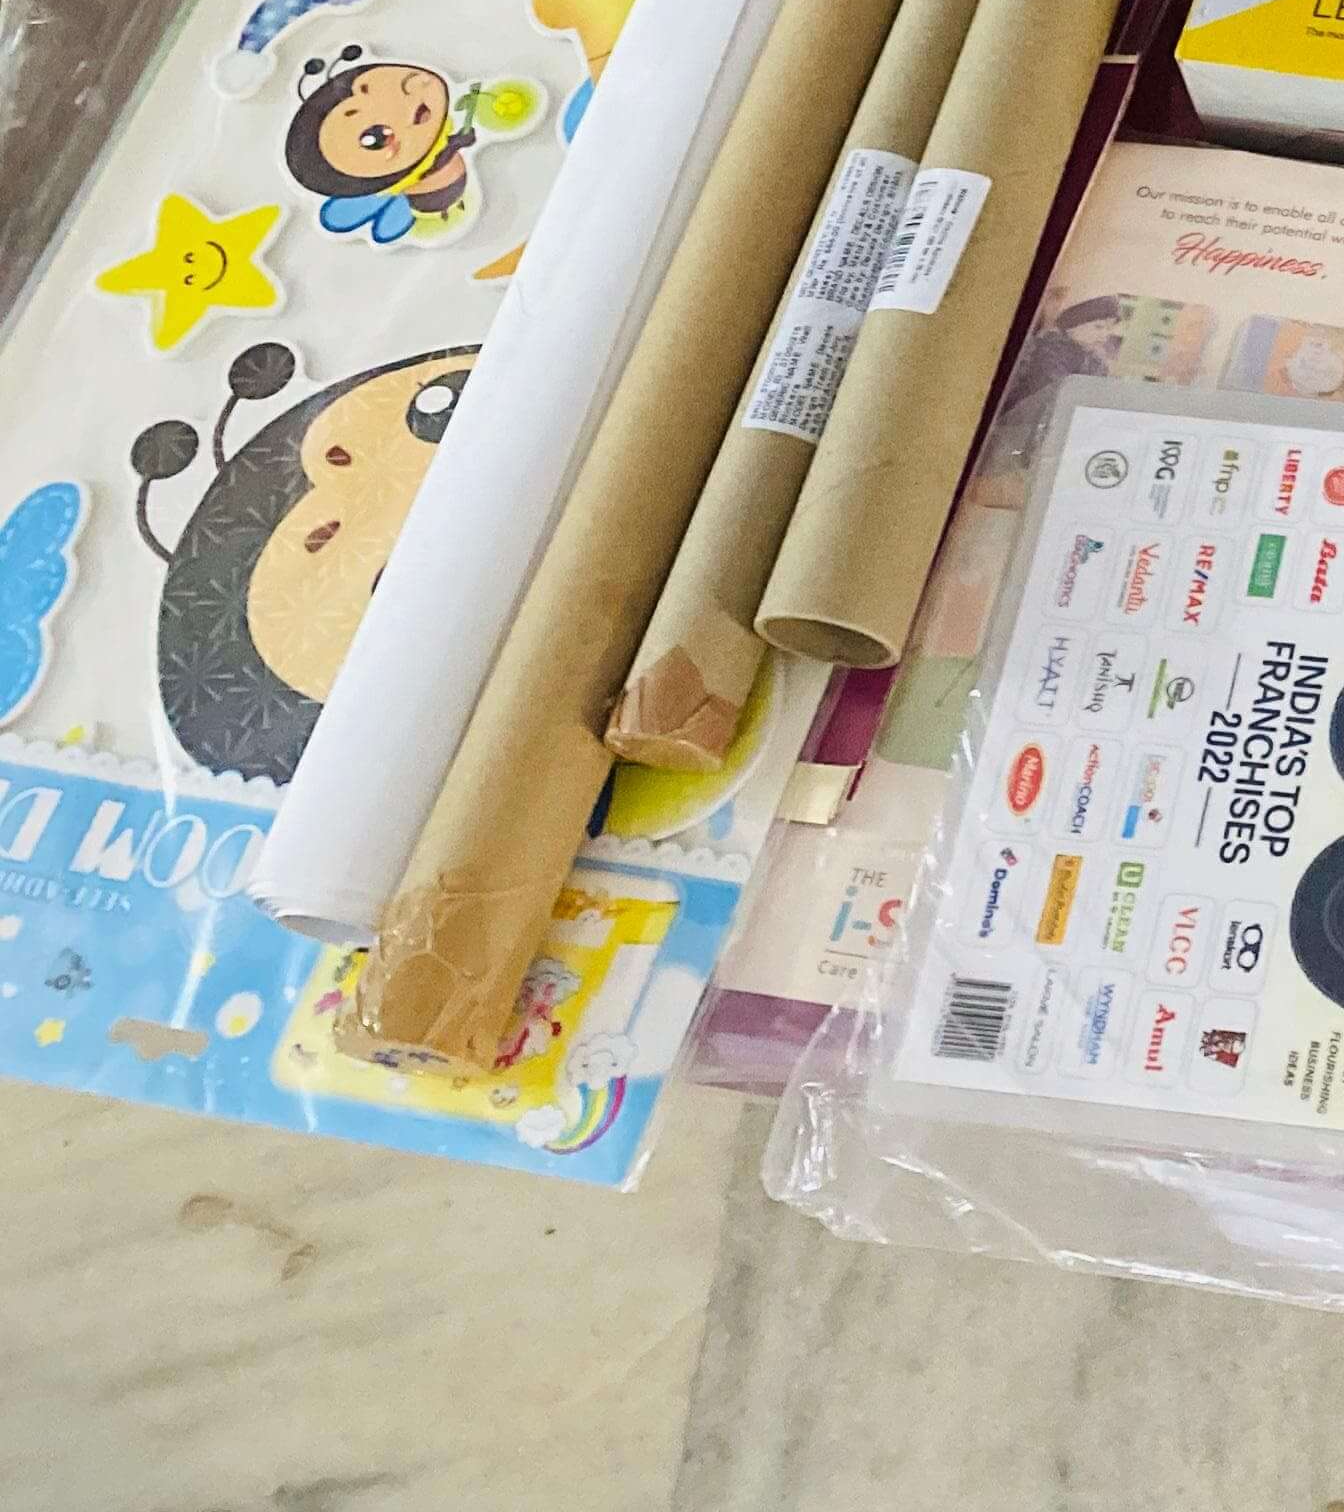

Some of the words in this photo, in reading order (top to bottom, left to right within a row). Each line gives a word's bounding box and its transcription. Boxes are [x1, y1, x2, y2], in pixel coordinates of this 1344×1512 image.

[1135, 185, 1166, 201] Our
[1169, 190, 1224, 210] mission
[1229, 196, 1240, 211] is
[1244, 198, 1259, 213] to
[1263, 201, 1314, 221] enable
[1317, 207, 1337, 225] all
[1161, 207, 1176, 221] to
[1180, 210, 1222, 228] reach
[1225, 213, 1258, 233] their
[1262, 221, 1328, 244] potential
[1274, 449, 1301, 516] LIBERTY
[1122, 542, 1160, 616] Vedantu
[1182, 544, 1217, 626] RE/MAX
[1310, 538, 1338, 605] Bata
[1037, 637, 1069, 709] HYATT
[1197, 710, 1244, 785] 2022
[1276, 654, 1330, 777] INDIA'S
[1218, 639, 1297, 866] FRANCHISES
[1258, 786, 1300, 858] TOP
[853, 868, 888, 887] THE
[978, 867, 1008, 940] Domino's
[817, 960, 858, 980] Care
[1165, 907, 1199, 976] VLCC
[1220, 920, 1242, 970] lenskart
[1087, 983, 1116, 1065] WYNDHAM
[1144, 1004, 1176, 1072] Amul
[1284, 1051, 1299, 1087] IDEAS
[1300, 1041, 1321, 1101] BUSINESS
[1316, 1031, 1342, 1115] FLOURISHING
